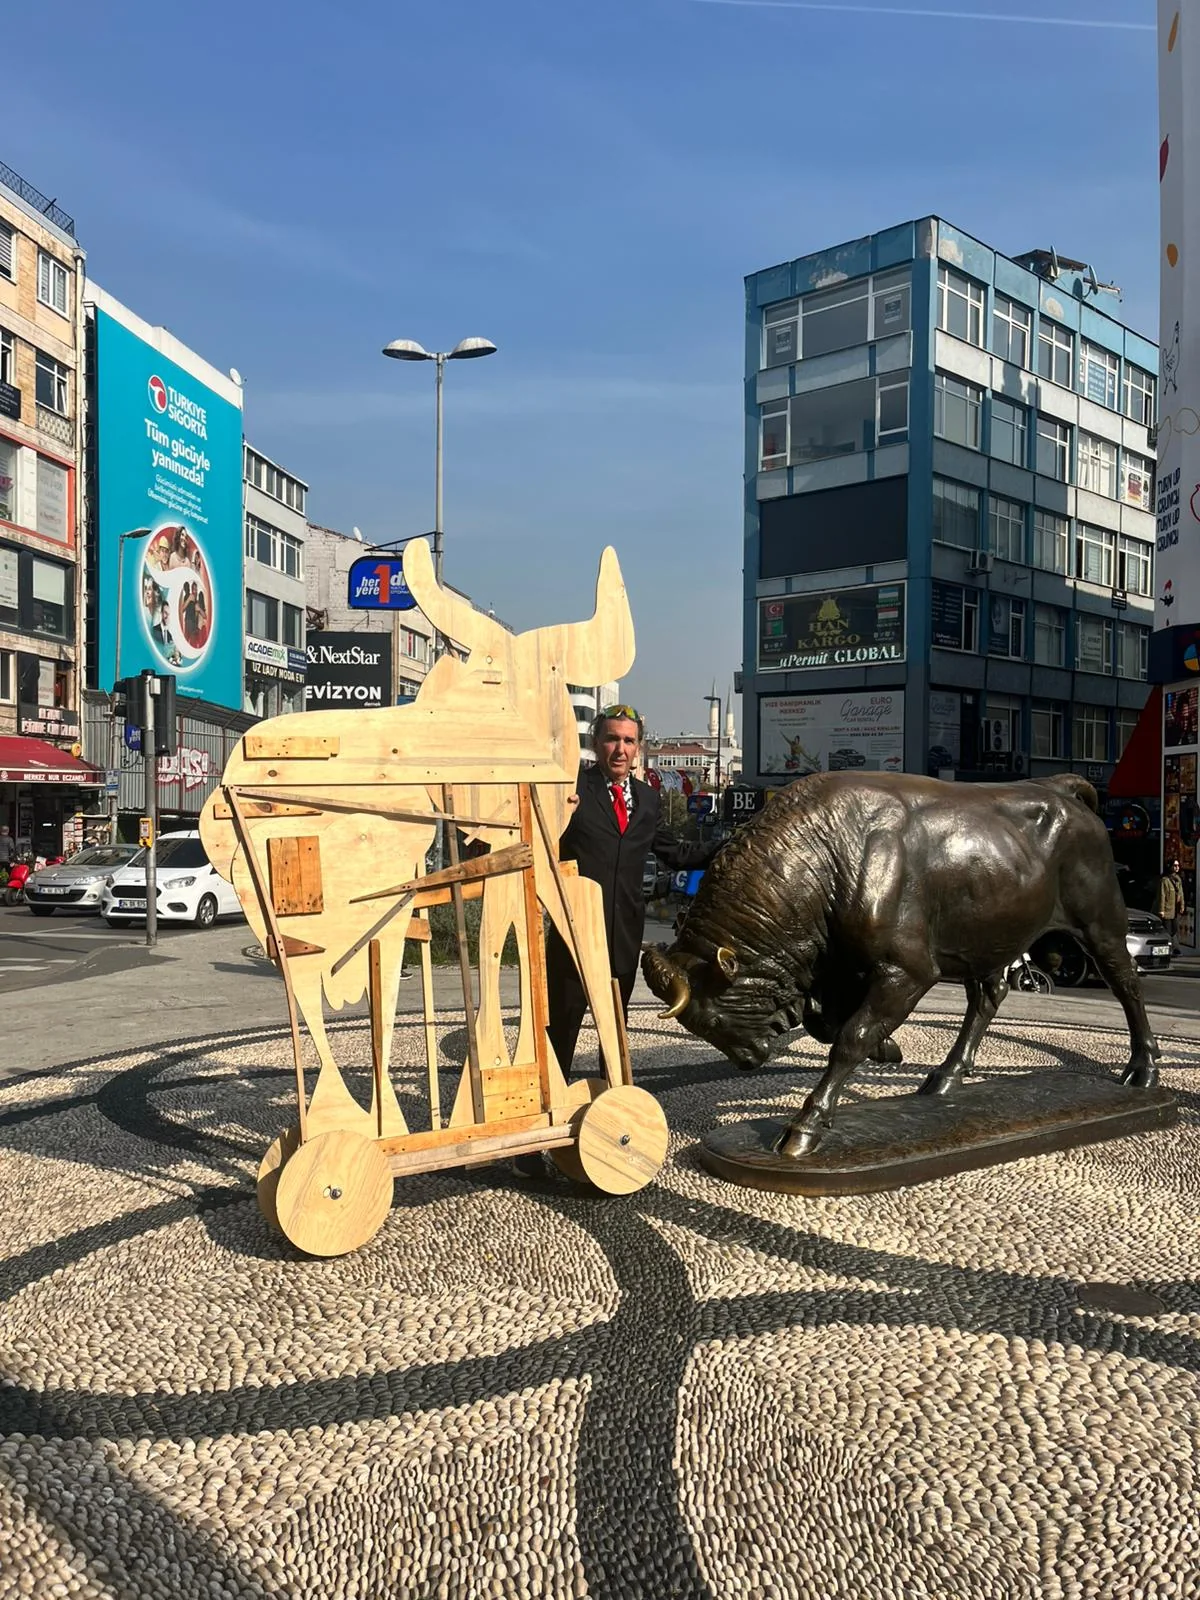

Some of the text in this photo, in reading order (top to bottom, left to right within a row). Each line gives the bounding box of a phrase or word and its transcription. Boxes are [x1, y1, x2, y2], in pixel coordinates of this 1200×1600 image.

[144, 418, 210, 471] Tüm gücüyle
[152, 449, 204, 488] yanınızda!
[361, 576, 380, 587] her
[355, 586, 380, 598] yere
[808, 619, 849, 632] HAN
[797, 634, 861, 649] KARGO
[306, 645, 319, 664] &
[319, 645, 381, 665] NextStar
[834, 645, 901, 663] GLOBAL
[262, 664, 278, 677] LADY
[278, 668, 295, 682] MODA
[870, 696, 893, 705] EURO
[840, 698, 893, 722] Garage
[23, 773, 46, 781] MERKEZ
[732, 791, 756, 810] BE
